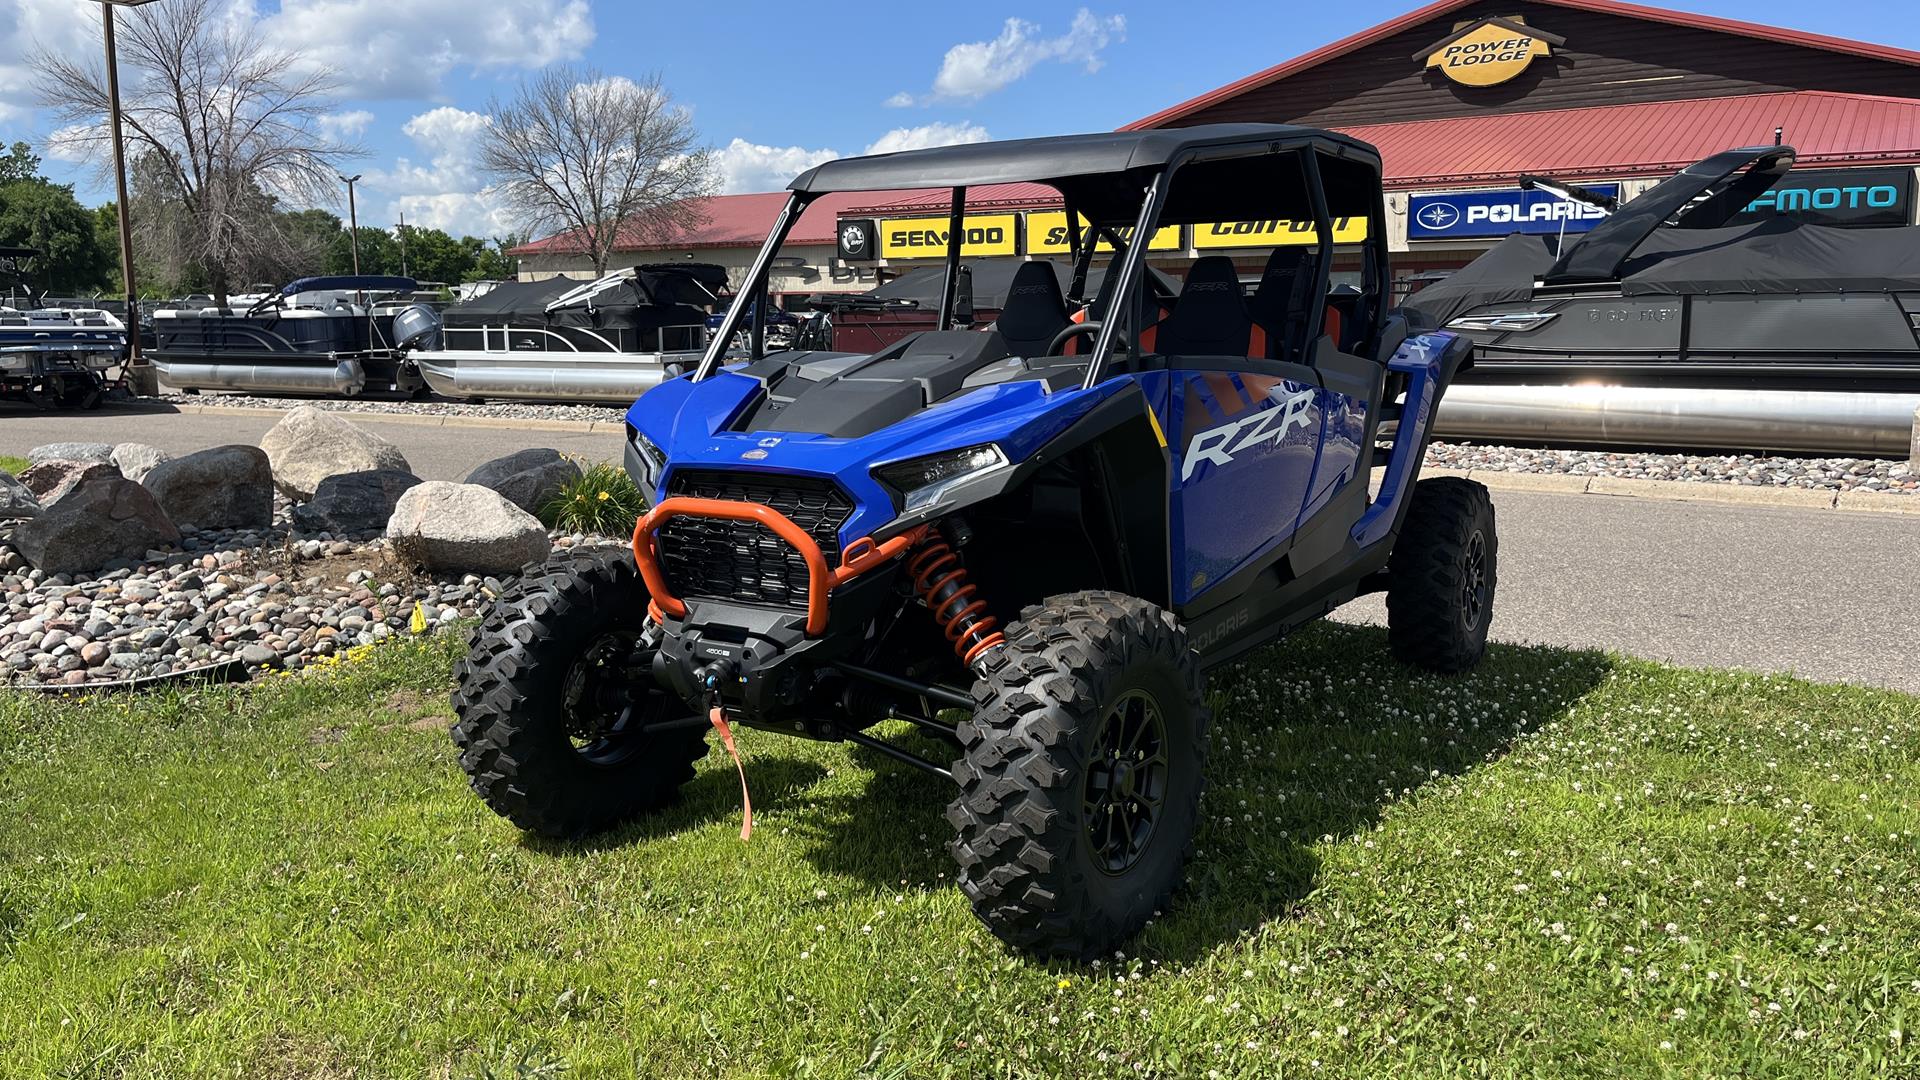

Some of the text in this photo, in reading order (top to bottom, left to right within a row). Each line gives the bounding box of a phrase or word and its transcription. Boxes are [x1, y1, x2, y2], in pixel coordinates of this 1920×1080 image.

[1444, 38, 1532, 58] POWER
[1448, 50, 1528, 67] LODGE
[1740, 185, 1897, 212] FMOTO
[1467, 202, 1606, 223] POLARIS
[1182, 388, 1316, 483] RZR
